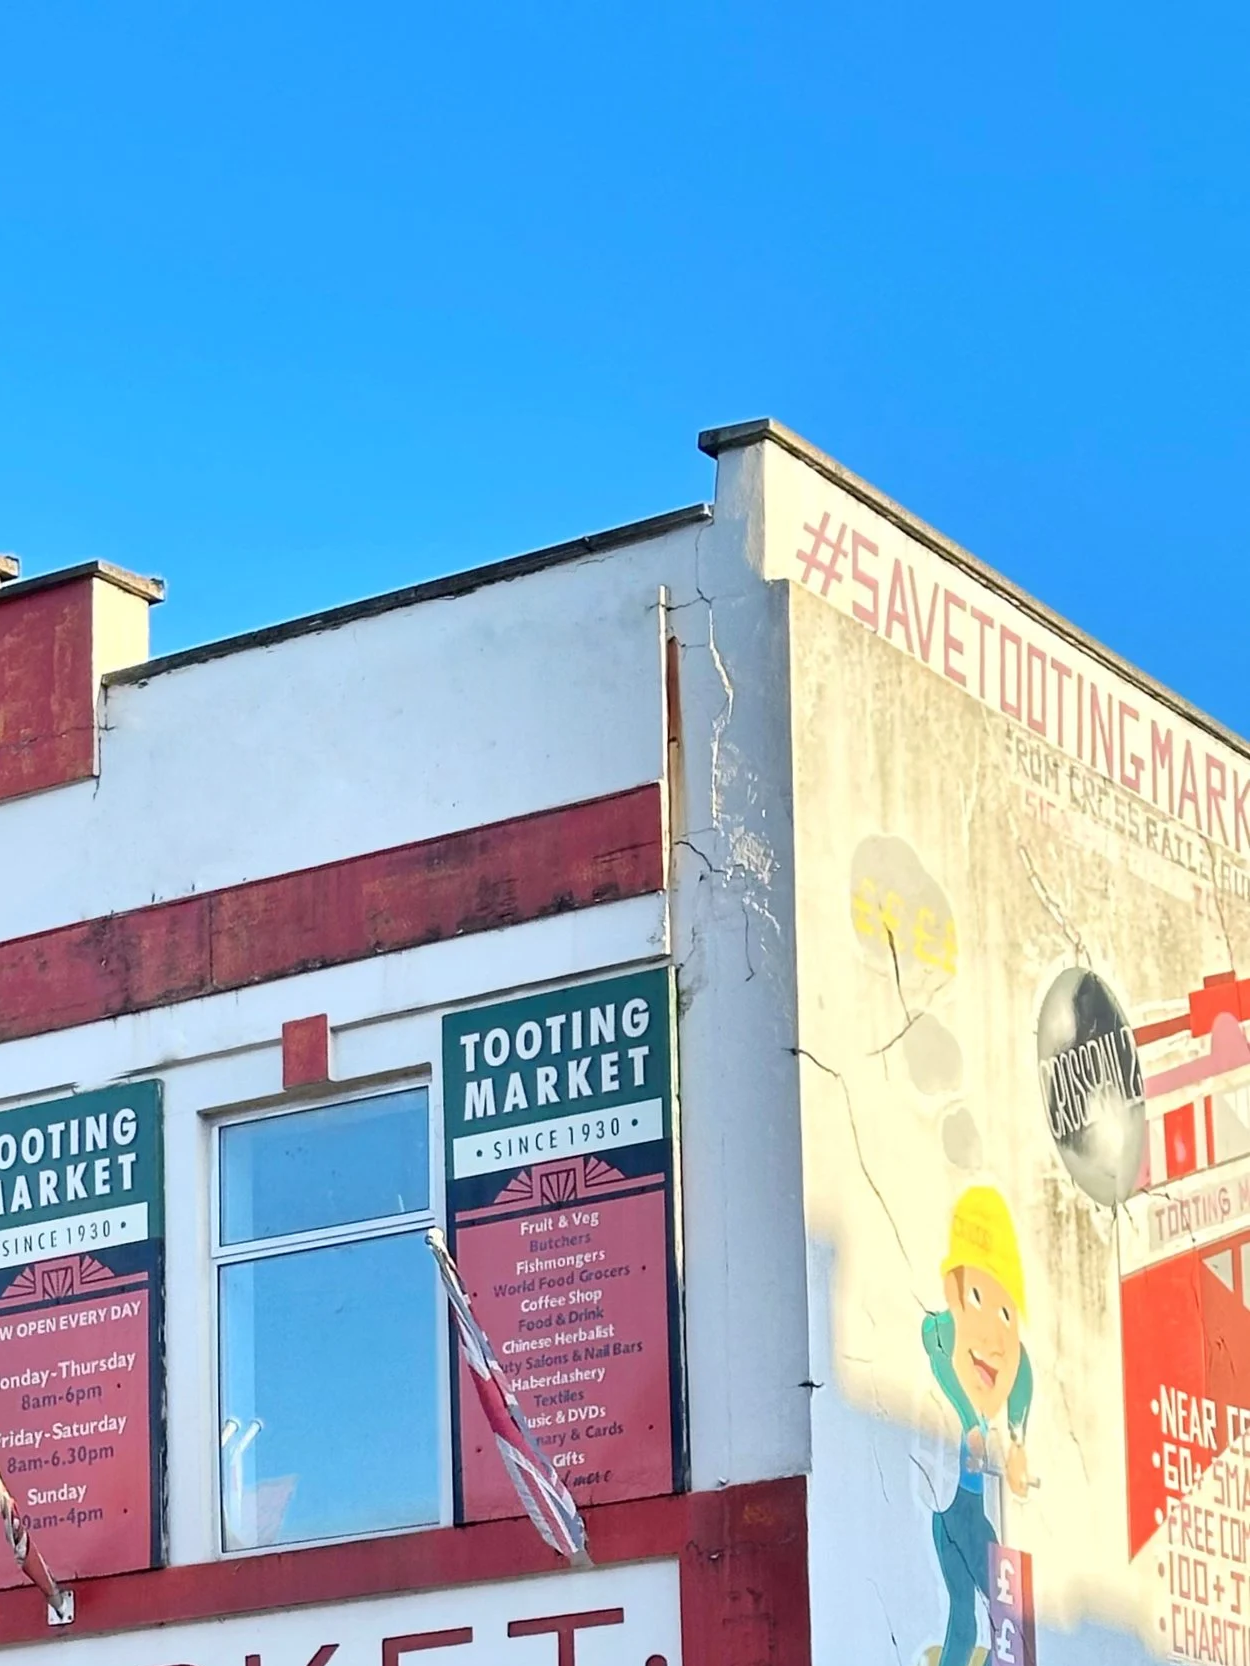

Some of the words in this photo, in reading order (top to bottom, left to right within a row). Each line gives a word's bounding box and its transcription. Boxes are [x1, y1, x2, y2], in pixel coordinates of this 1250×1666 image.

[460, 997, 650, 1073] TOOTING
[464, 1046, 650, 1121] MARKET
[494, 1130, 558, 1160] SINCE
[568, 1117, 620, 1146] 1930
[520, 1218, 553, 1236] Fruit
[558, 1215, 569, 1228] &
[572, 1211, 600, 1227] Veg
[1155, 1187, 1231, 1241] TOOTING
[2, 1230, 57, 1257] SINCE
[66, 1220, 111, 1245] 1930
[529, 1232, 591, 1253] Butchers
[516, 1249, 605, 1276] Fishmongers
[493, 1279, 535, 1297] World
[539, 1271, 574, 1289] Food
[579, 1264, 631, 1282] Grocers
[521, 1294, 566, 1313] Coffee
[568, 1288, 602, 1306] Shop
[16, 1317, 56, 1339] OPEN
[59, 1307, 107, 1331] EVERY
[110, 1300, 142, 1320] DAY
[519, 1315, 552, 1332] Food
[556, 1312, 566, 1326] &
[568, 1306, 605, 1324] Drink
[502, 1337, 551, 1354] Chinese
[554, 1324, 615, 1345] Herbalist
[526, 1353, 569, 1370] Salons
[572, 1351, 583, 1363] &
[584, 1344, 610, 1360] Nail
[612, 1341, 644, 1357] Bars
[511, 1366, 606, 1392] Haberdashery
[21, 1384, 103, 1411] 8am-6pm
[533, 1389, 585, 1408] Textiles
[524, 1413, 552, 1429] usic
[555, 1411, 566, 1424] &
[568, 1405, 606, 1422] DVDs
[570, 1428, 581, 1441] &
[585, 1421, 624, 1438] Cards
[1160, 1384, 1217, 1450] NEAR
[6, 1444, 114, 1474] 8am-6.30pm
[553, 1451, 585, 1468] Gifts
[27, 1483, 87, 1506] Sunday
[1166, 1496, 1216, 1555] FREE
